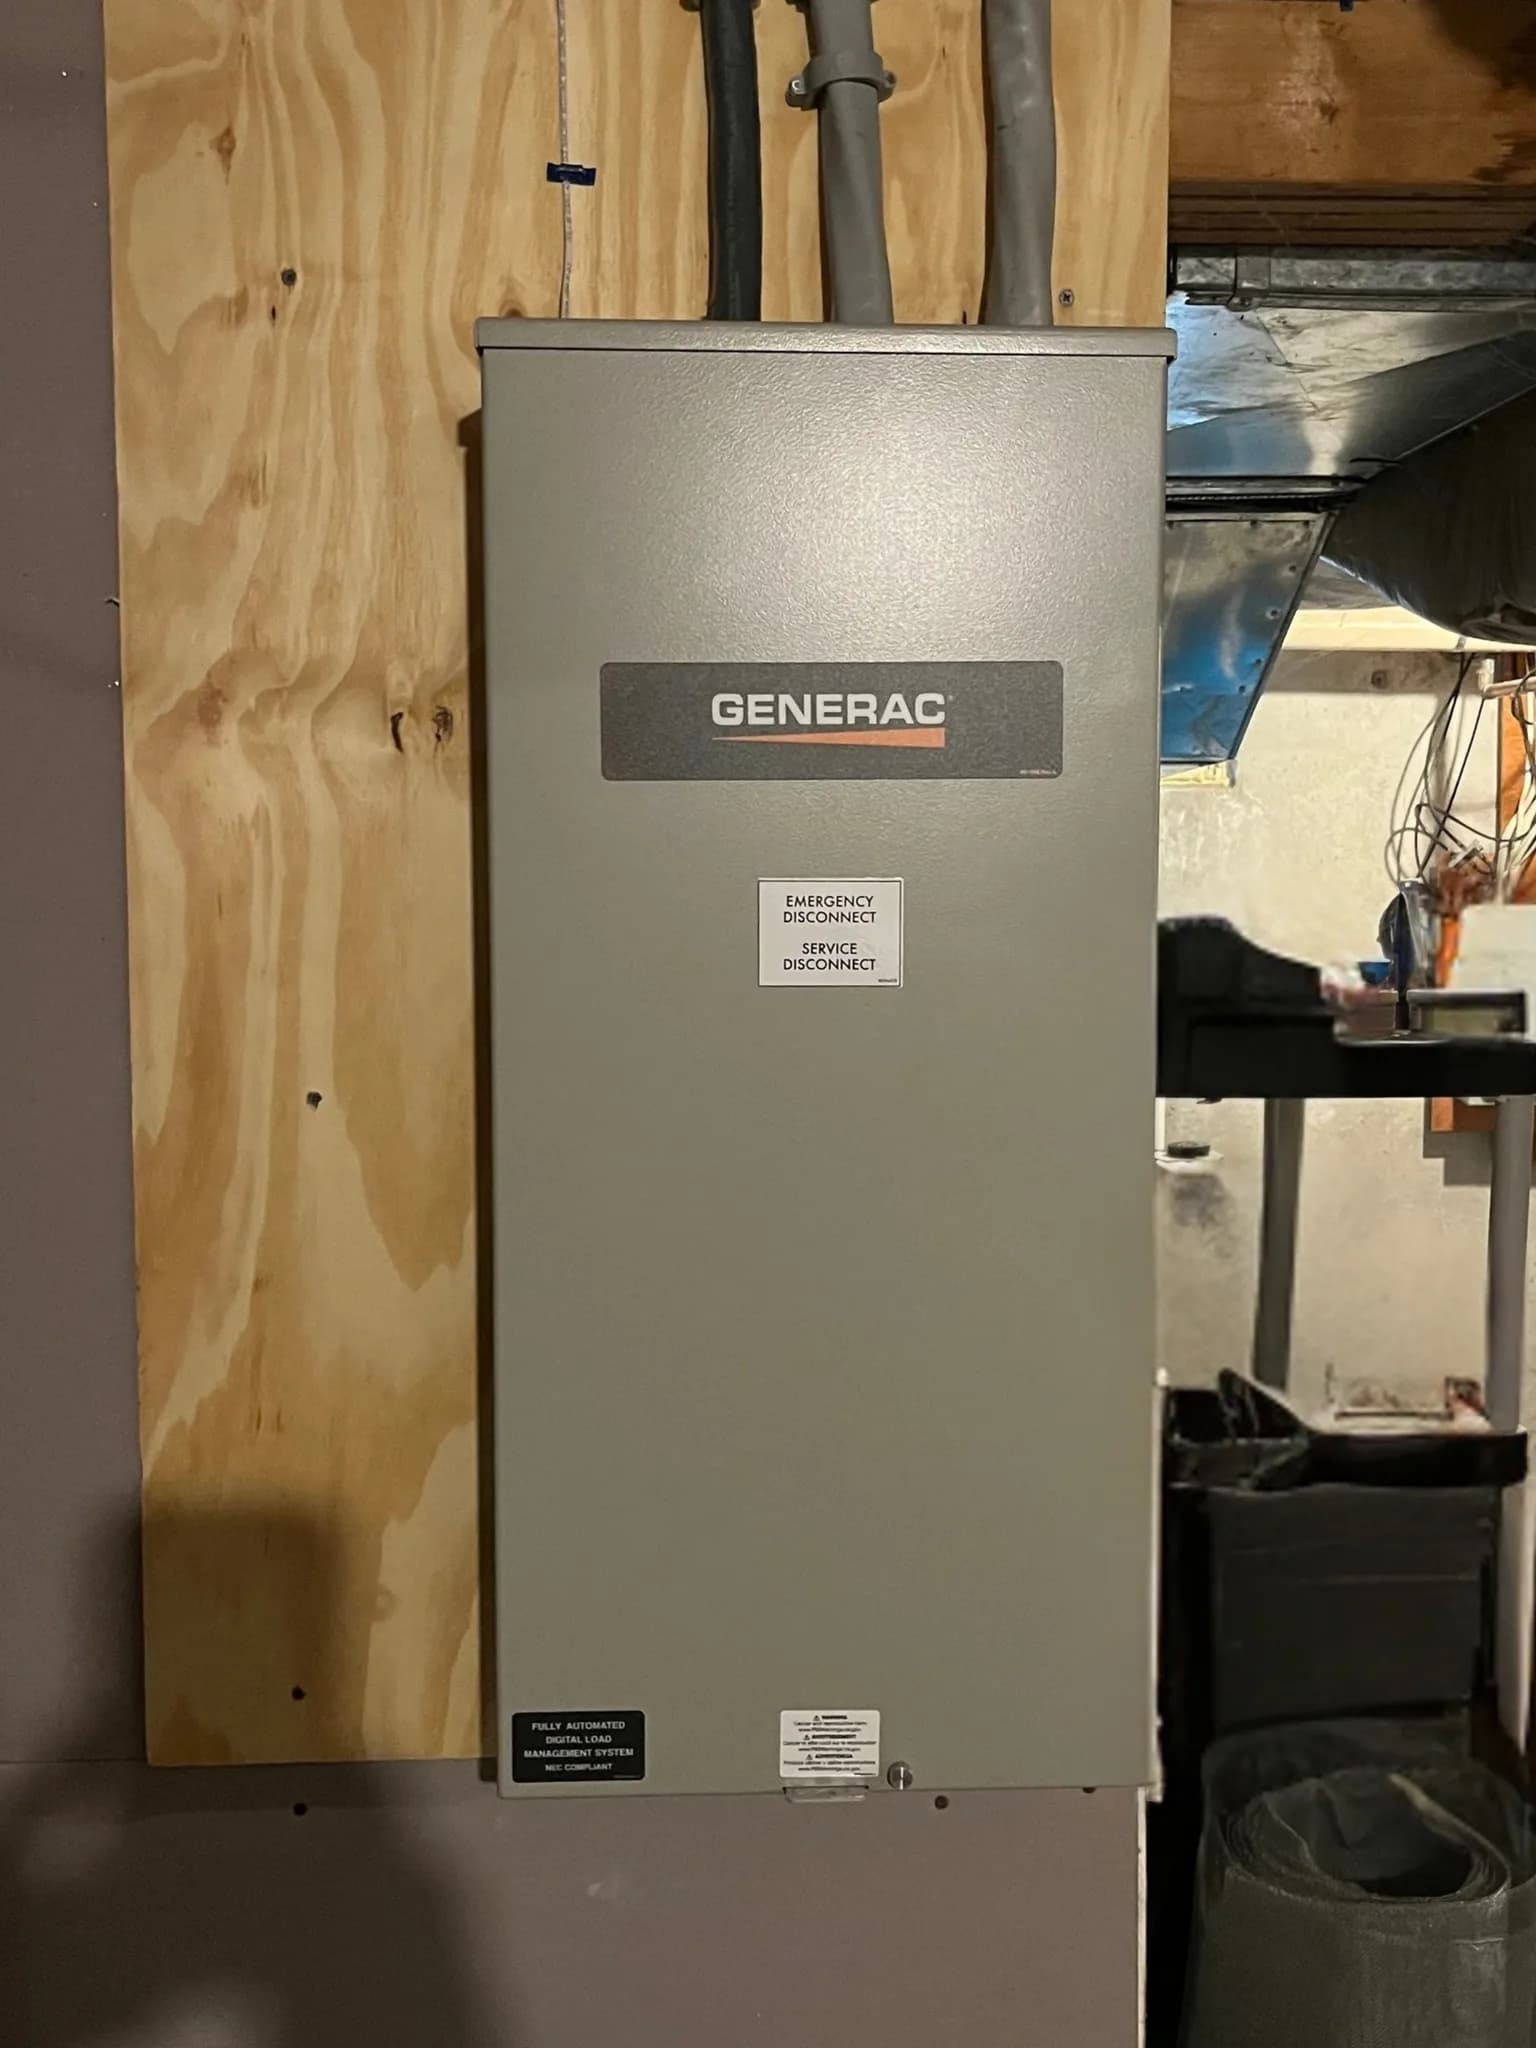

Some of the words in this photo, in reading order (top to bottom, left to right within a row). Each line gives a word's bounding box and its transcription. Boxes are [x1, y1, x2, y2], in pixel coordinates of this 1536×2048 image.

[711, 692, 946, 725] GENERAC
[785, 895, 874, 908] EMERGENCY
[783, 911, 877, 923] DISCONNECT
[802, 942, 857, 954] SERVICE
[783, 958, 876, 971] DISCONNECT
[531, 1722, 562, 1731] FULLY
[566, 1721, 626, 1730] AUTOMATED
[545, 1735, 582, 1744] DIGITAL
[585, 1735, 612, 1743] LOAD
[523, 1749, 592, 1758] MANAGEMENT
[594, 1748, 634, 1757] SYSTEM
[564, 1763, 613, 1771] COMPLIANT
